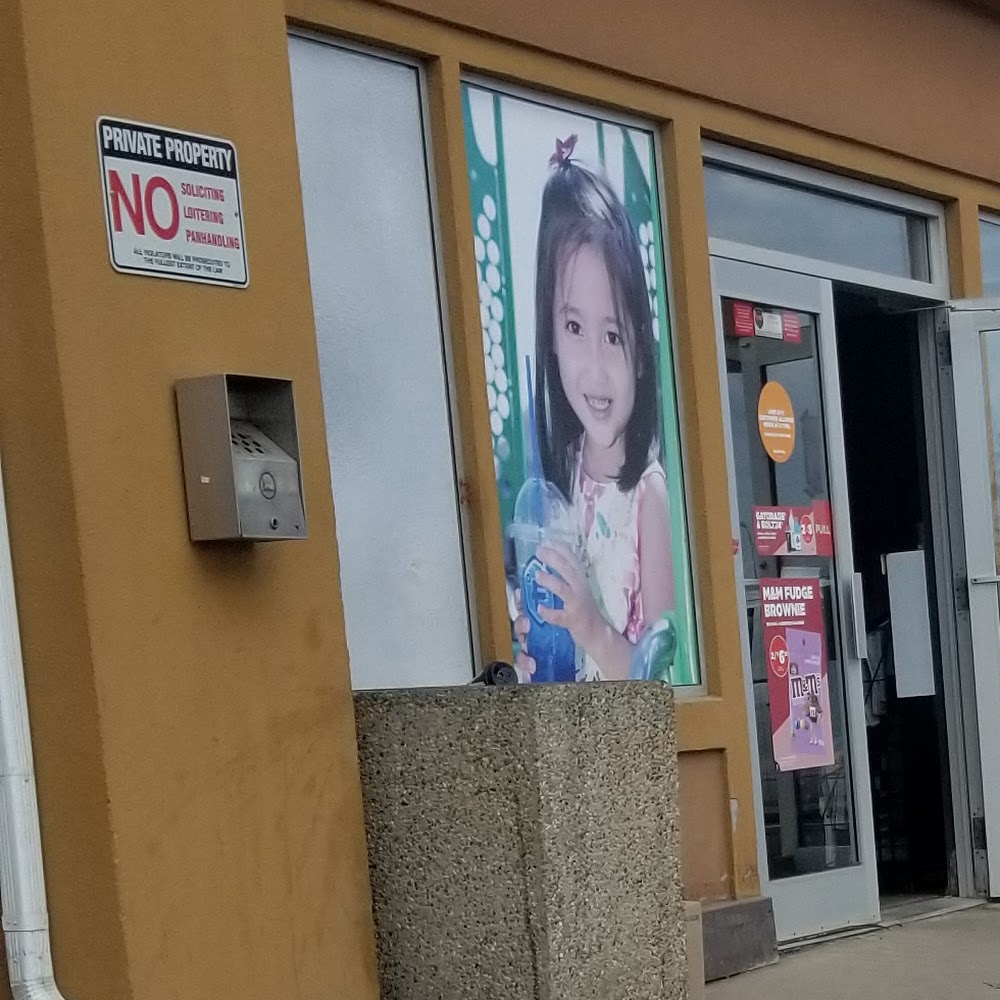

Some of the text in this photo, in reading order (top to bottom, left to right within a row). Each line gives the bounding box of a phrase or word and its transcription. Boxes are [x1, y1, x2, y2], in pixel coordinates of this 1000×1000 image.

[101, 125, 233, 172] PRIVATE PROPERTY
[181, 182, 225, 203] SOLICITING
[108, 169, 180, 241] NO
[183, 206, 224, 225] LOITERING
[185, 229, 240, 250] PANHANDLING
[762, 586, 814, 600] M&M FUDGE
[764, 602, 806, 618] BROWNIE
